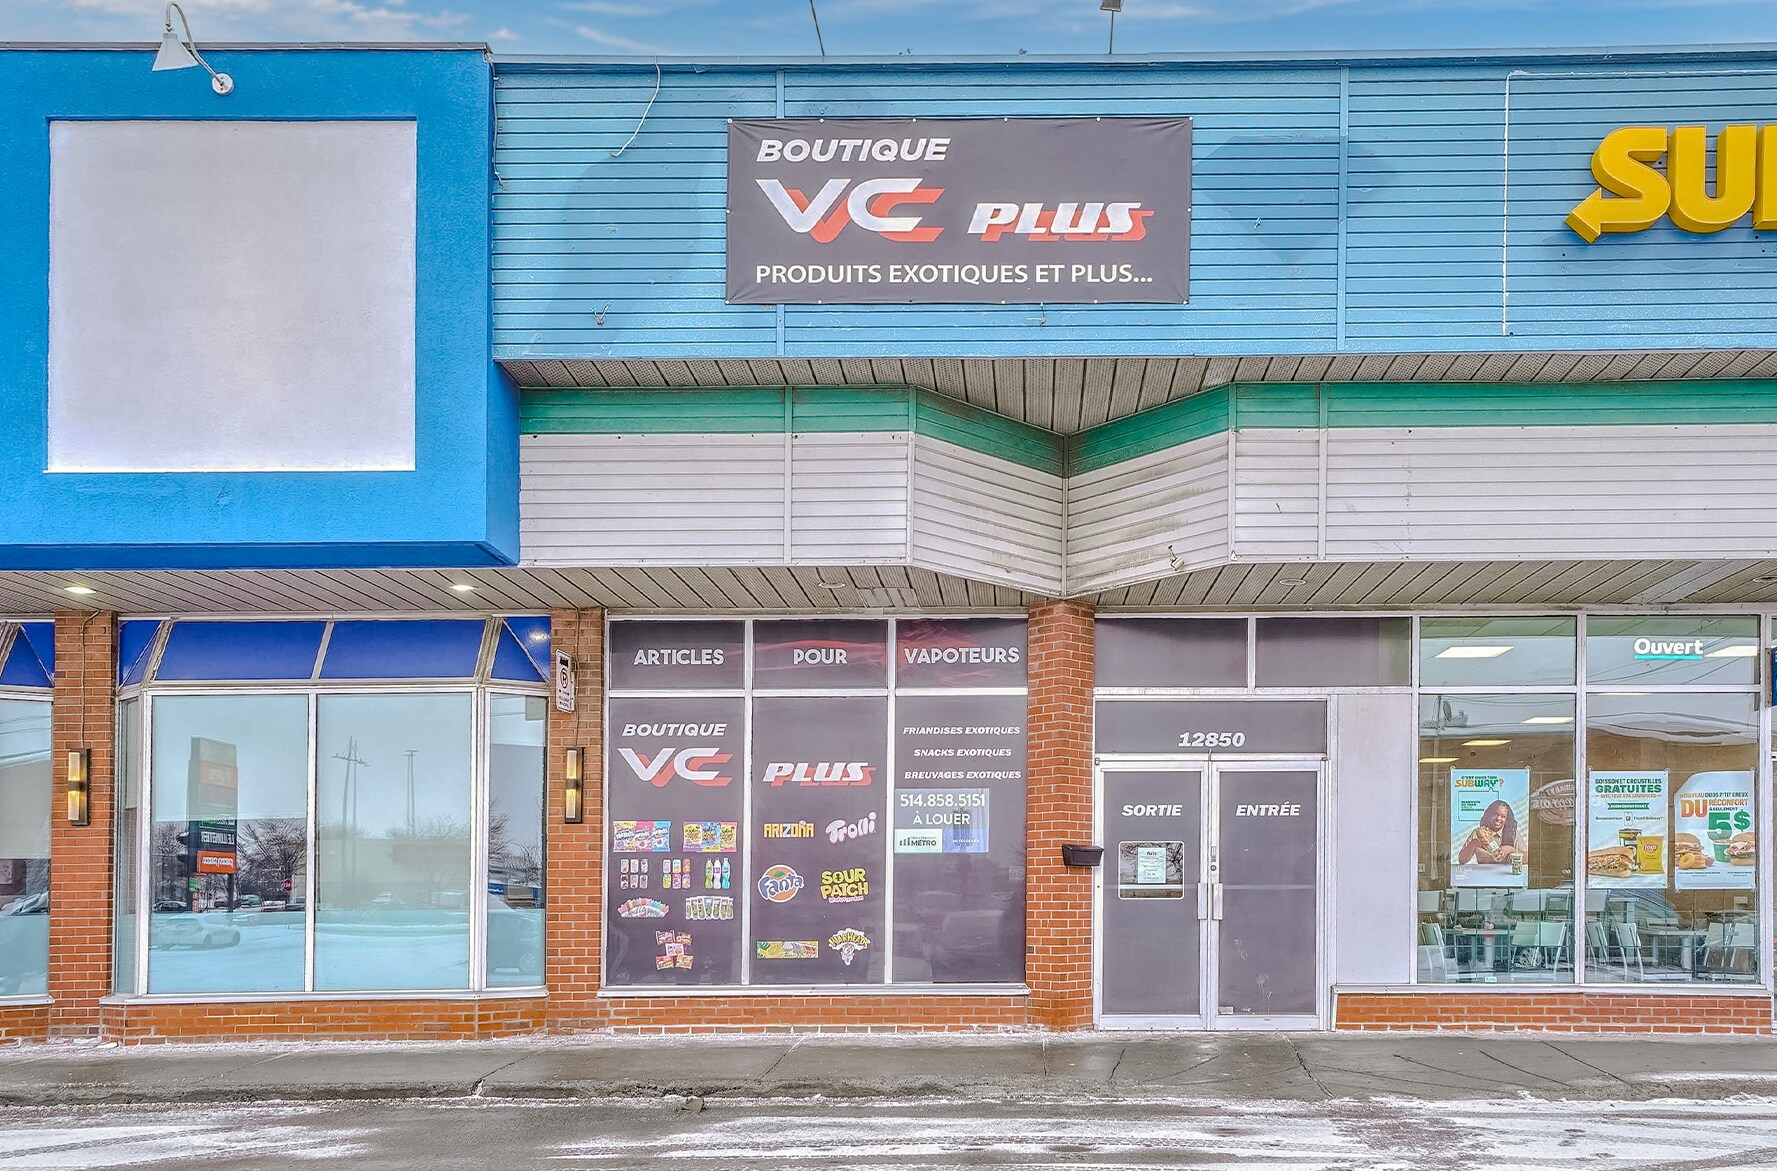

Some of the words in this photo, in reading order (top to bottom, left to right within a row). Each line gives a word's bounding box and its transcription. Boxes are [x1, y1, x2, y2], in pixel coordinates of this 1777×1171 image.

[756, 137, 951, 163] BOUTIQUE
[755, 178, 945, 243] VC
[967, 202, 1154, 242] PLUS
[756, 264, 882, 284] PRODUITS
[889, 264, 1028, 286] EXOTIQUES
[1035, 264, 1065, 283] ET
[1072, 264, 1153, 283] PLUS...
[903, 646, 1020, 665] VAPOTEURS
[1633, 638, 1704, 656] Ouvert
[633, 649, 724, 666] ARTICLES
[793, 648, 847, 665] POUR
[622, 723, 727, 738] BOUTIQUE
[902, 727, 963, 736] FRIANDISES
[964, 727, 1020, 736] EXOTIQUES
[1178, 732, 1246, 747] 12850
[913, 748, 955, 757] SNACKS
[956, 748, 1012, 758] EXOTIQUES
[618, 747, 733, 787] VC
[763, 762, 876, 788] PLUS
[904, 770, 965, 780] BREUVAGES
[966, 770, 1021, 780] EXOTIQUES
[1595, 785, 1662, 793] GRATUITES
[900, 794, 985, 807] 514.858.5151
[1235, 800, 1301, 817] ENTRÉE
[1680, 799, 1708, 818] DU
[1709, 798, 1748, 806] RÉCONFORT
[912, 811, 922, 825] À
[926, 814, 970, 825] LOUER
[1121, 804, 1183, 817] SORTIE
[825, 811, 877, 843] Trolli
[1707, 809, 1751, 841] 5$
[821, 868, 866, 885] SOUR
[758, 873, 804, 899] Fanta
[820, 882, 869, 899] PATCH
